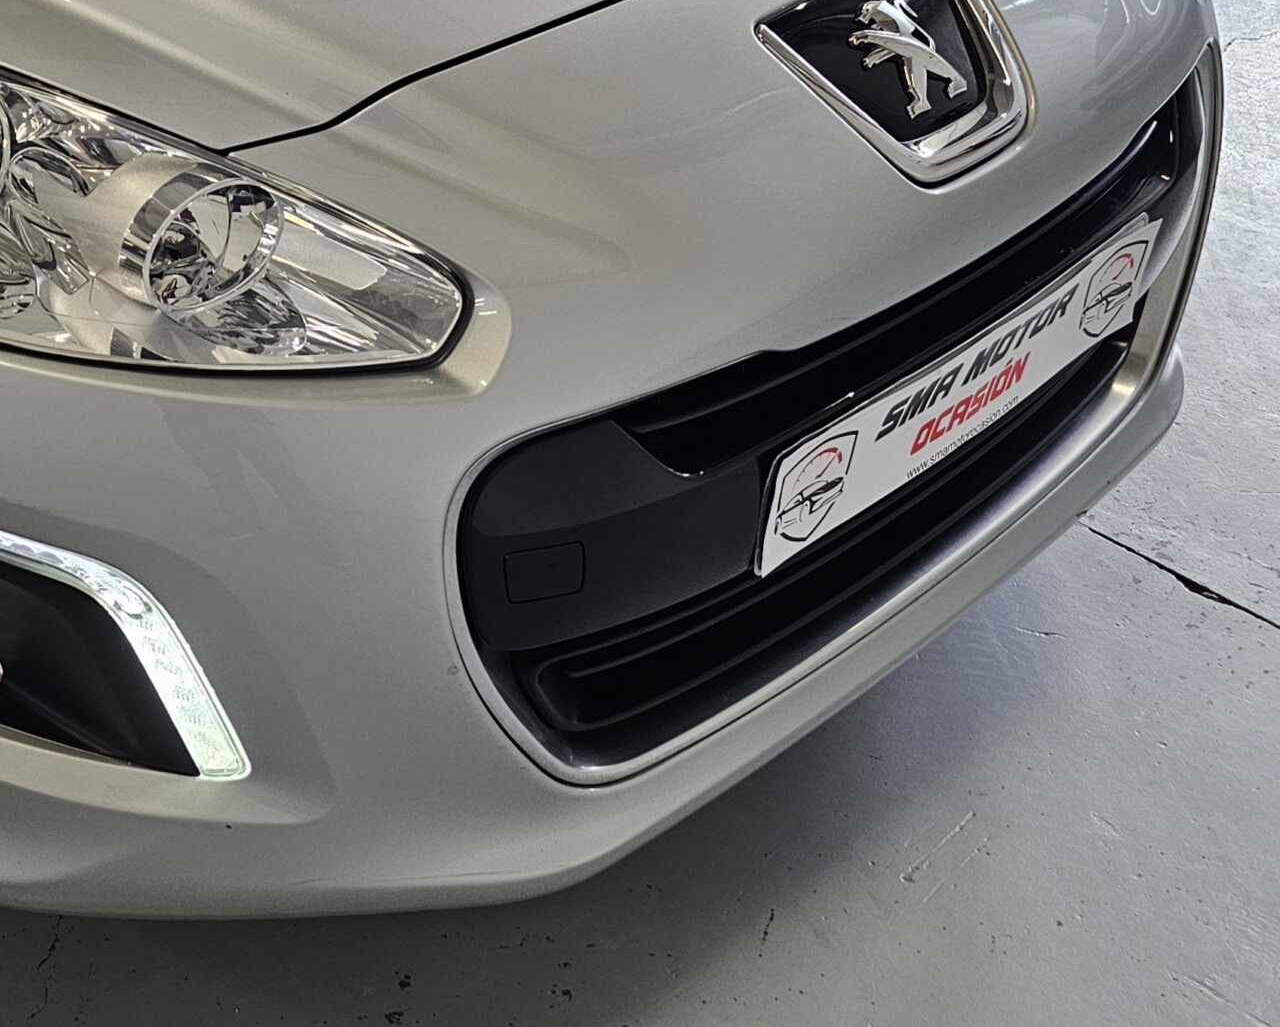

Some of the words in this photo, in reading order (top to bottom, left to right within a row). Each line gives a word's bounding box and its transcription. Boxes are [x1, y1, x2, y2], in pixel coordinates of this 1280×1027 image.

[874, 362, 965, 443] SMA
[960, 282, 1080, 387] MOTOR
[909, 351, 1031, 456] OCASIÓN
[906, 395, 1019, 479] www.smamotorocasion.com
